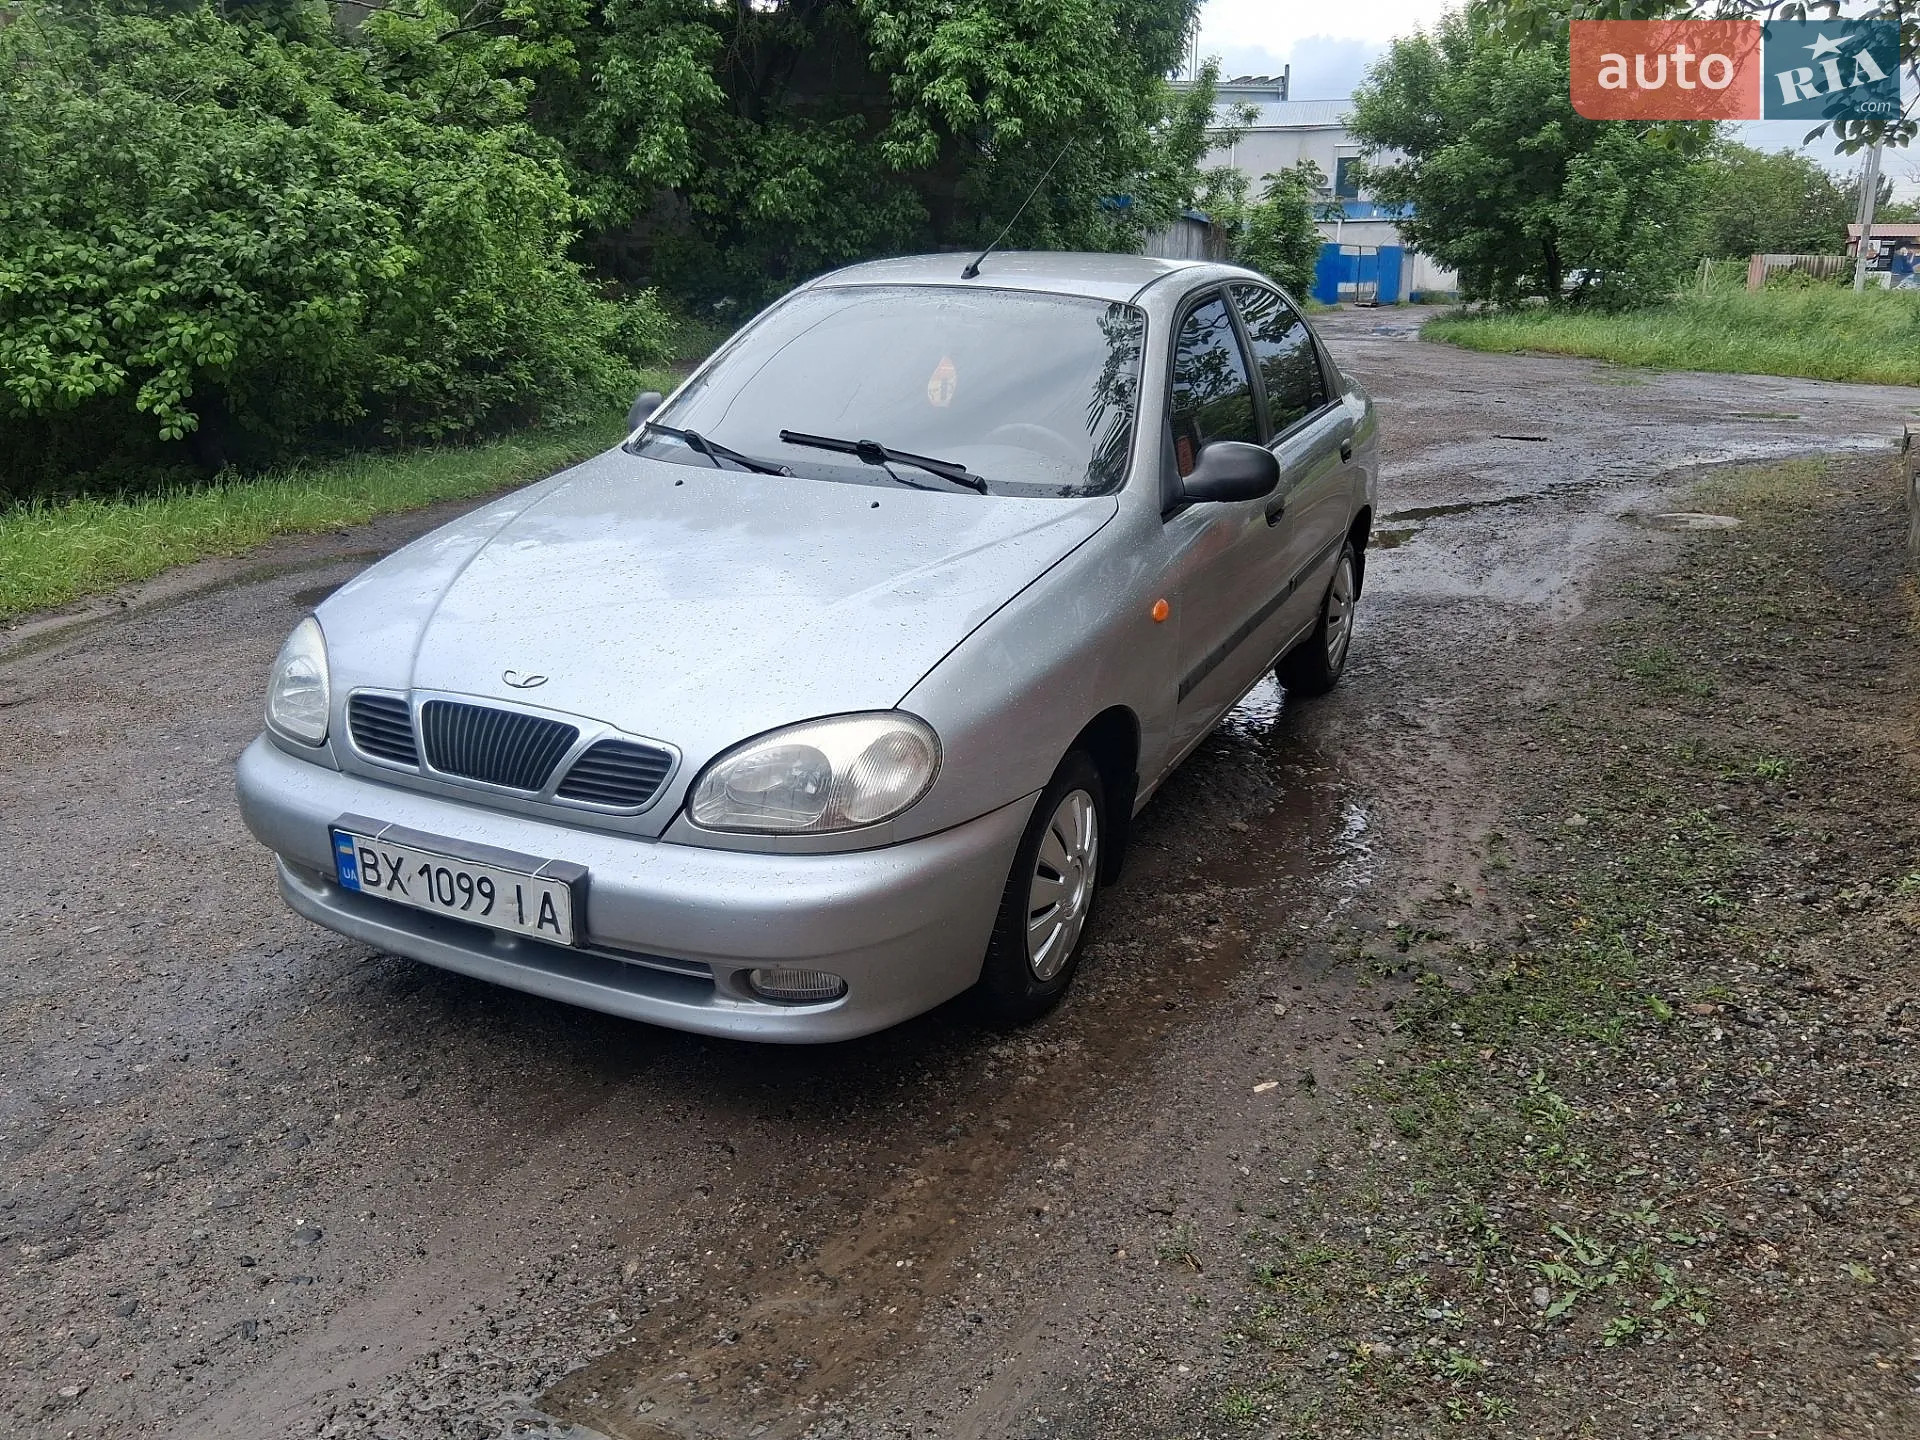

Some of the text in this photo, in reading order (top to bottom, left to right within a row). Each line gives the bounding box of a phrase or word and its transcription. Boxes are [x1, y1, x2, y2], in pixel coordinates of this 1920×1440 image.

[343, 867, 358, 881] UA
[358, 847, 562, 935] BX 1099 IA
